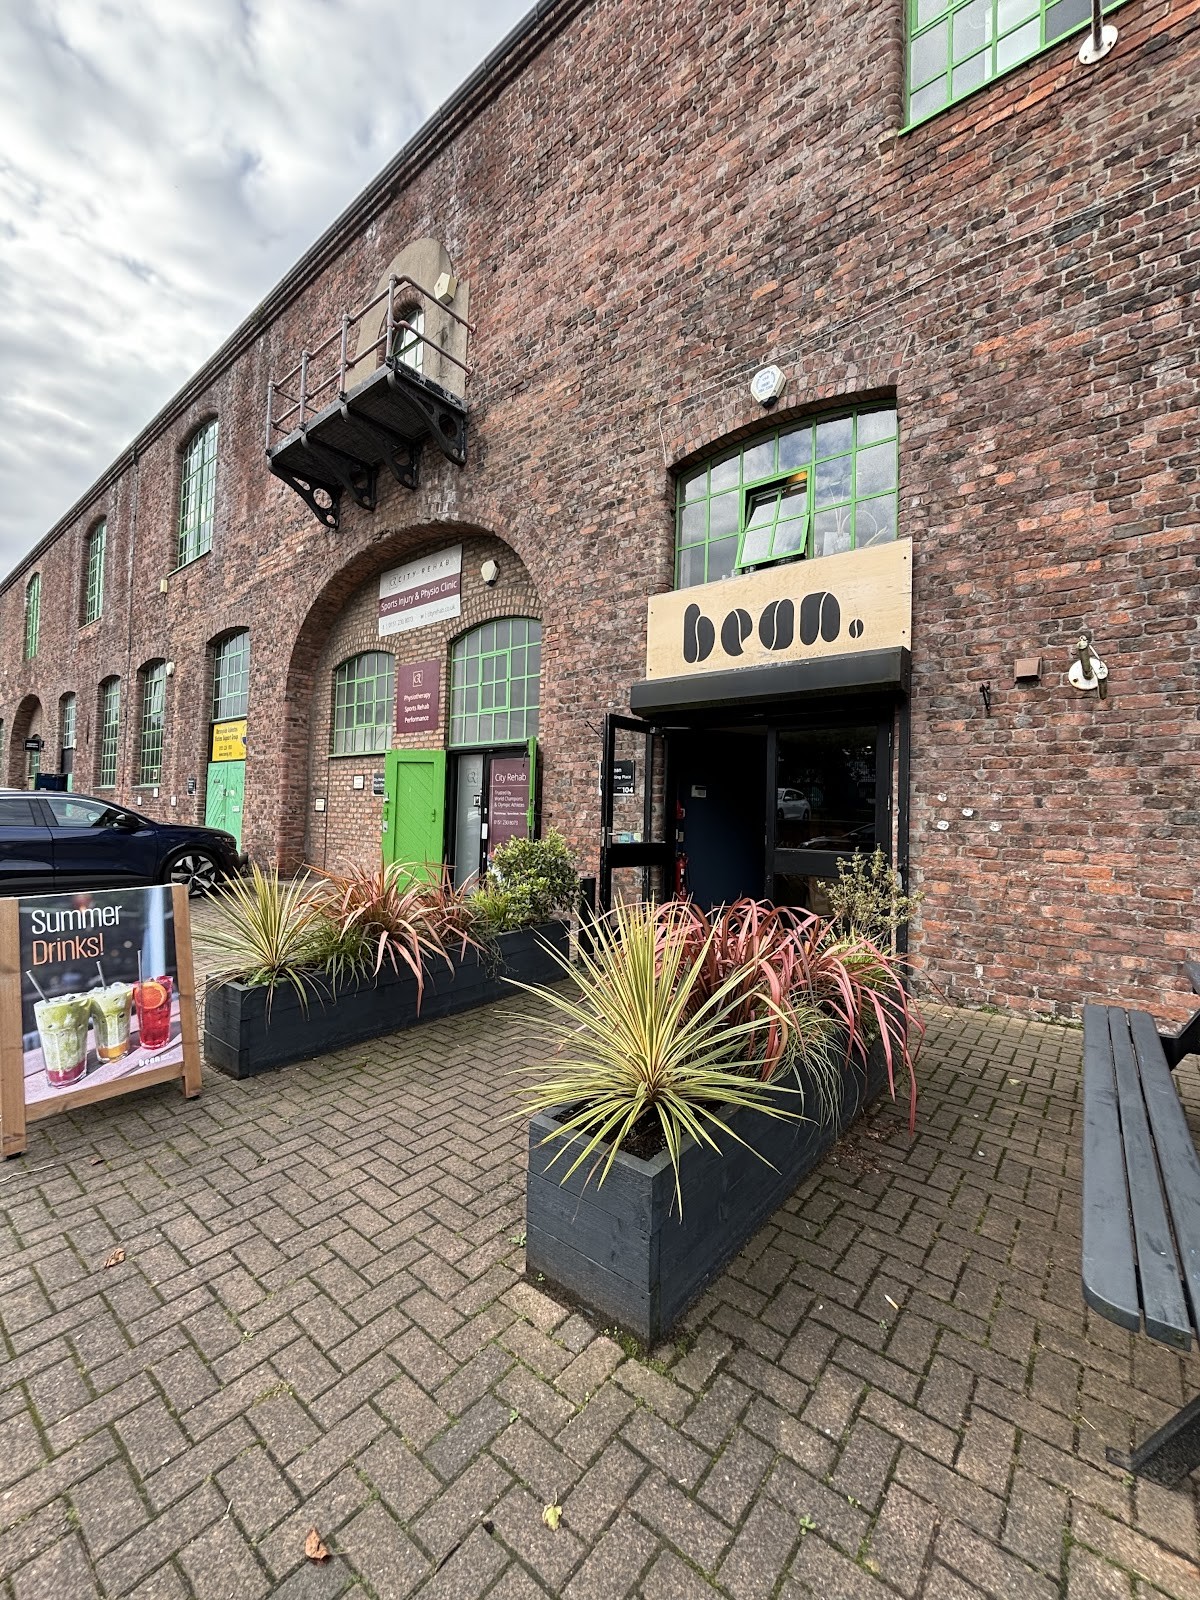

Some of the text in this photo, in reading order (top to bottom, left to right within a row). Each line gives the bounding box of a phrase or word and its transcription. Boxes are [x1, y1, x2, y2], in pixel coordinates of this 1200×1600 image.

[398, 570, 416, 583] CITY
[421, 559, 450, 574] REHAB
[380, 580, 458, 612] Sports Injury & Physio Clinic
[403, 692, 431, 703] Physiotherapy
[404, 703, 430, 713] Sports Rehab
[404, 715, 430, 724] Performance
[494, 772, 527, 784] City Rehab
[622, 786, 634, 794] 104
[31, 905, 122, 935] Summer
[32, 932, 104, 966] Drinks!
